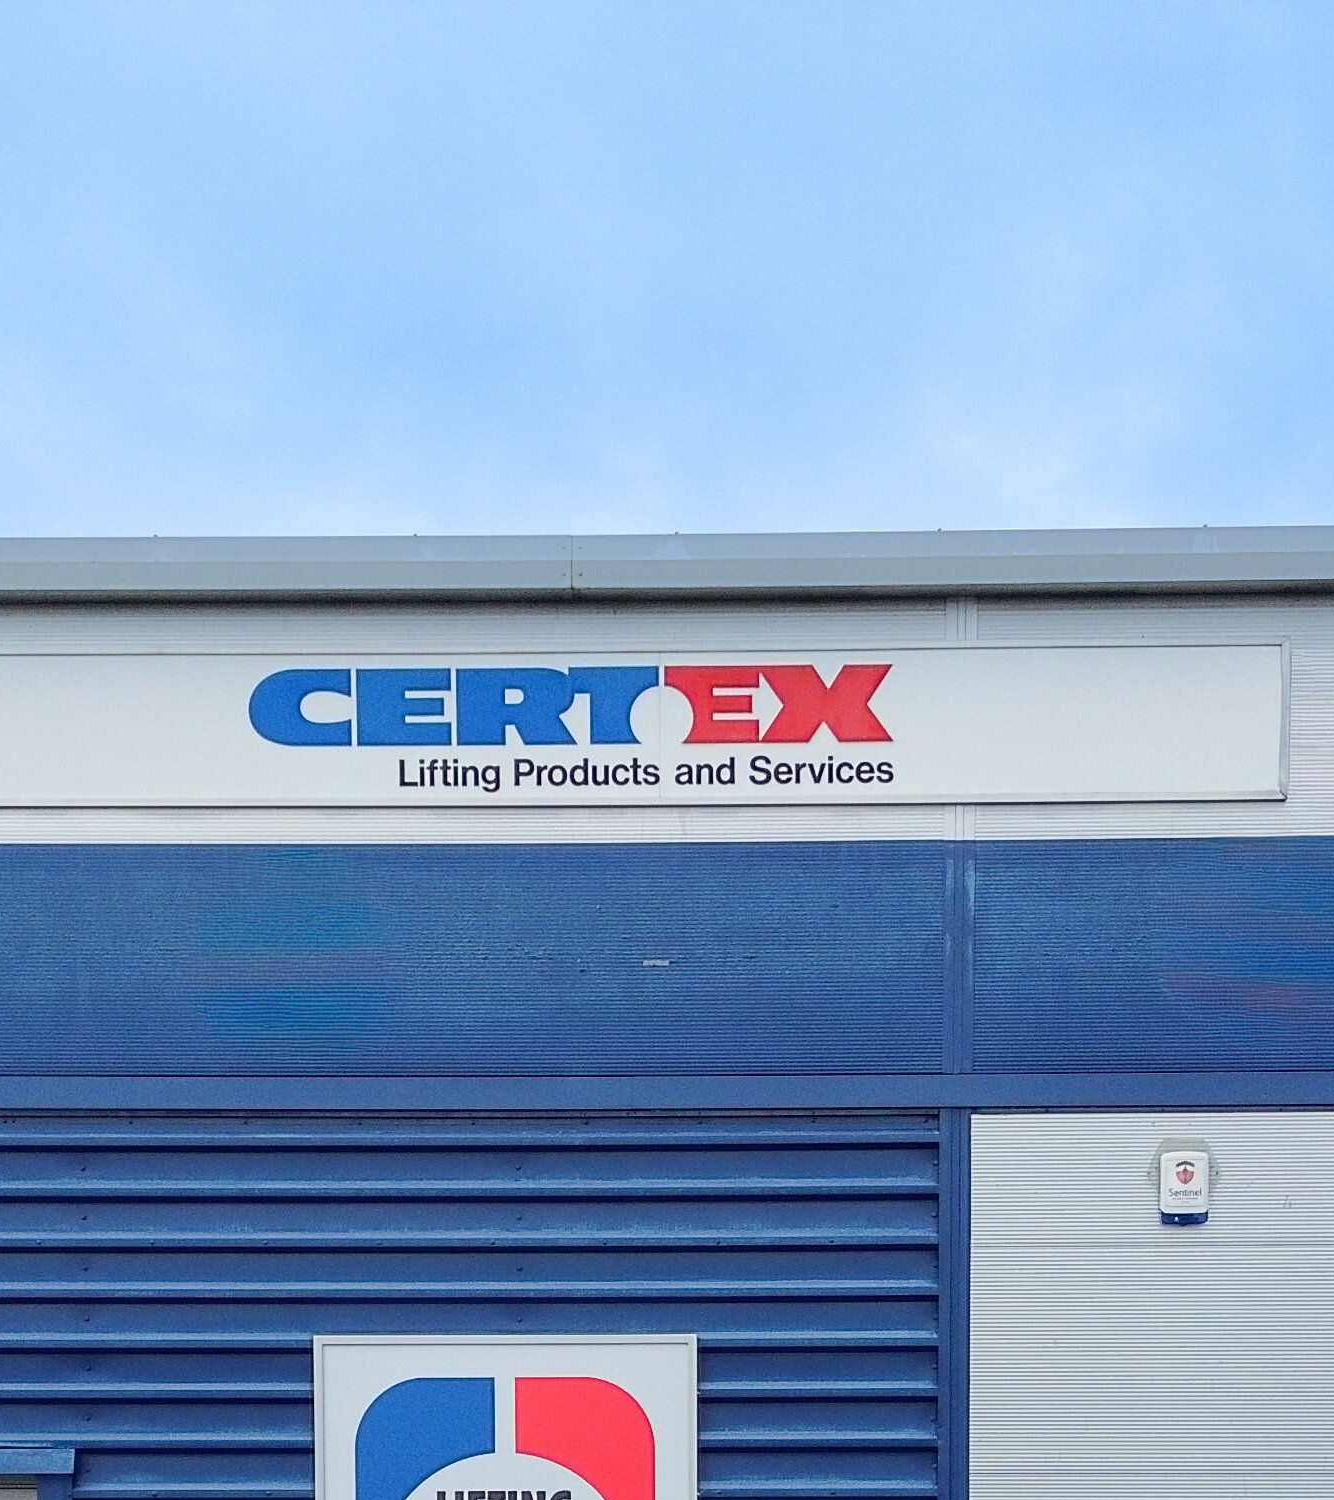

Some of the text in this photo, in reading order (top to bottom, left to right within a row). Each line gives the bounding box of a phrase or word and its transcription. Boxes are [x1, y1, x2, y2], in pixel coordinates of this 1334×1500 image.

[248, 663, 894, 747] CERTEX
[399, 755, 895, 792] Lifting Products and Services
